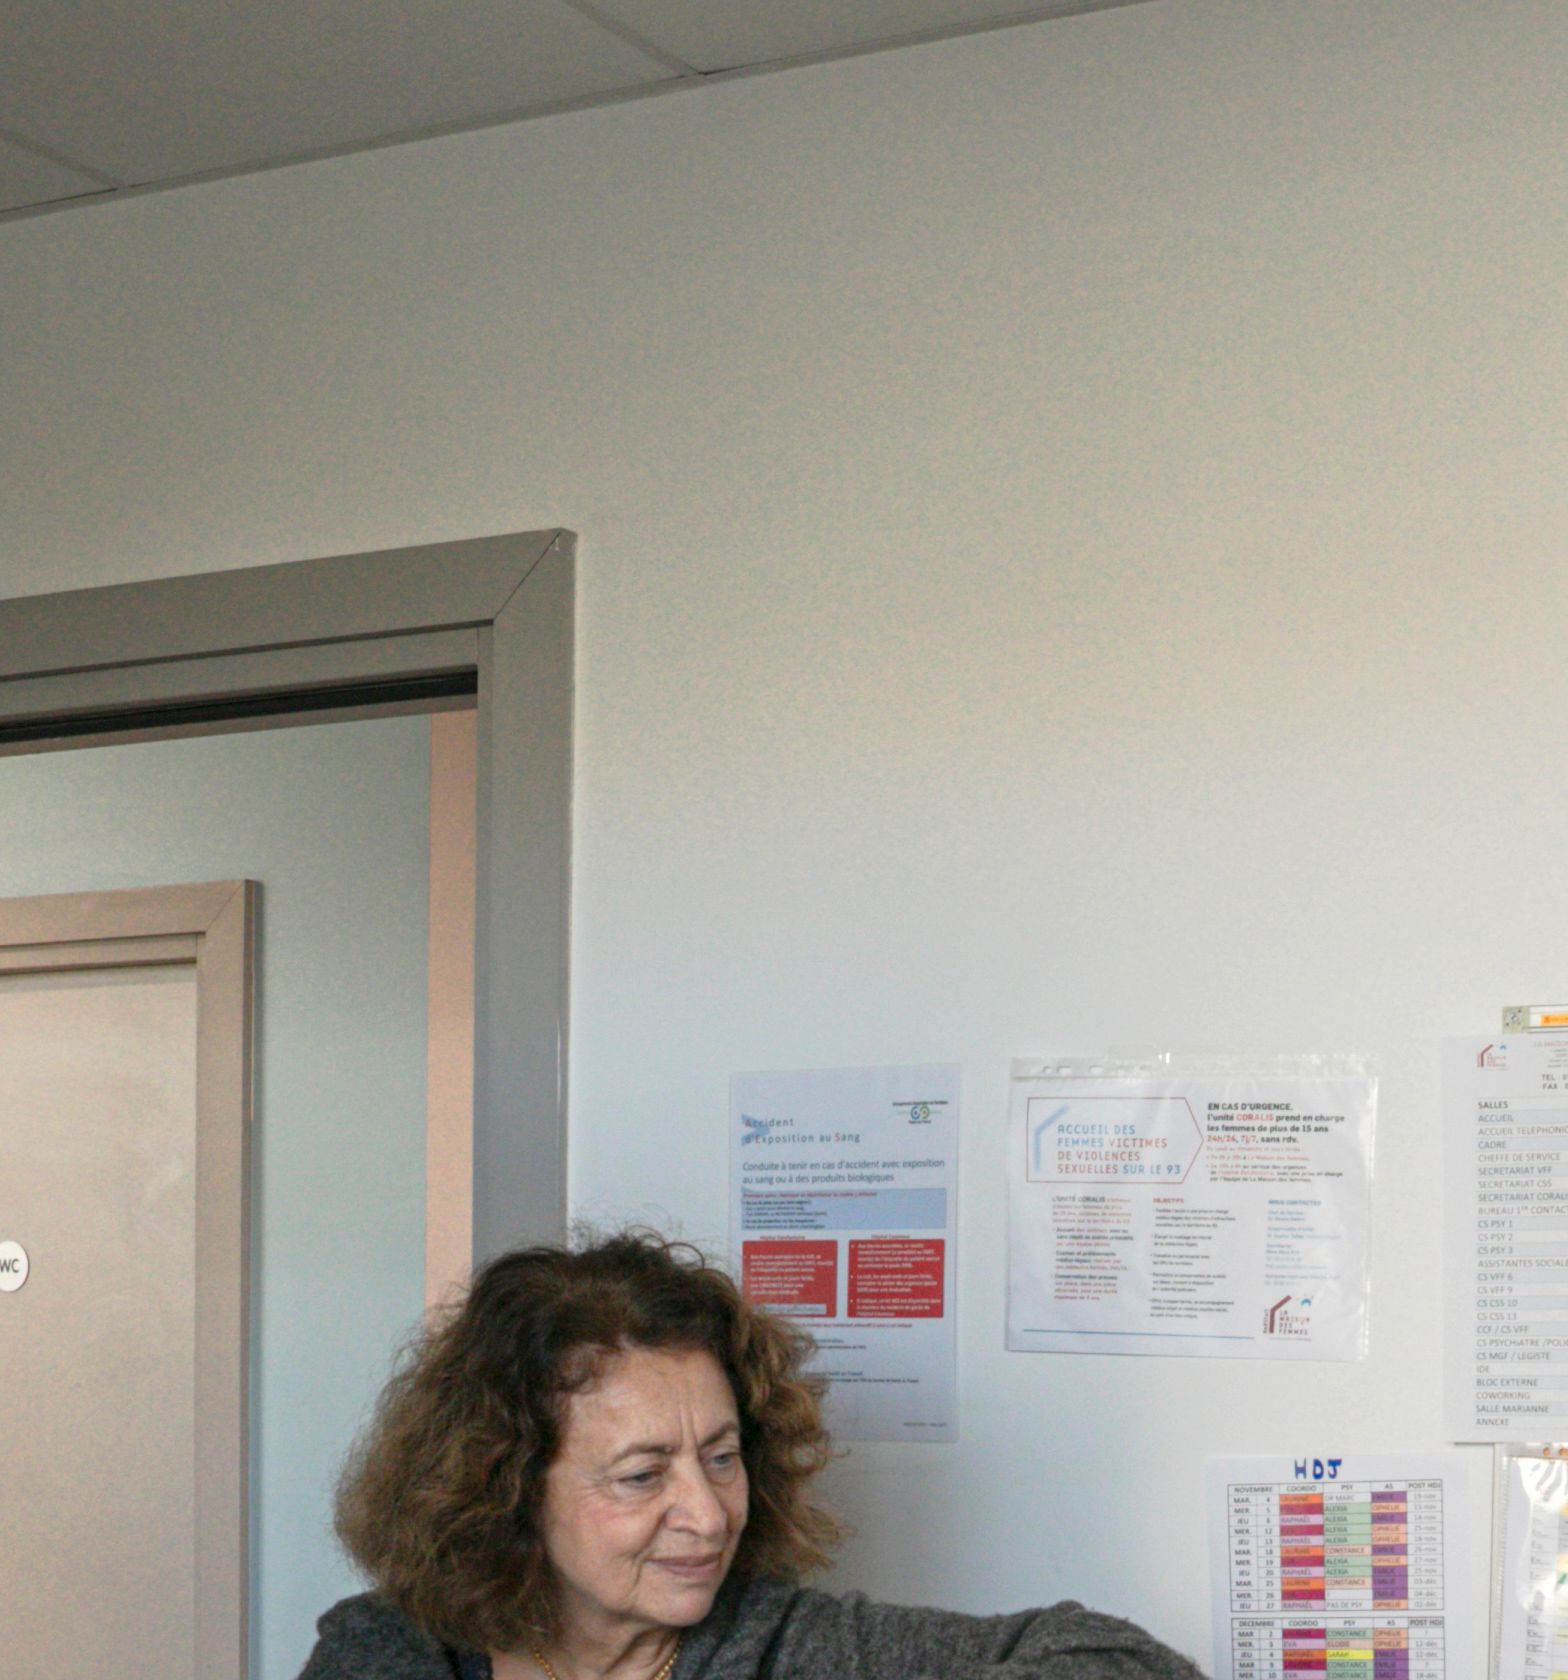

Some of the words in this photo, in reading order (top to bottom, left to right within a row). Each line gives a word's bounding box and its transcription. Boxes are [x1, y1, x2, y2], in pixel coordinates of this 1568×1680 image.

[1207, 1102, 1220, 1111] EN
[1222, 1102, 1239, 1111] CAS
[1478, 1100, 1508, 1110] SALLES
[745, 1118, 794, 1128] Accident
[1207, 1113, 1234, 1122] l'unité
[1236, 1113, 1274, 1122] CORALIS
[1275, 1114, 1300, 1123] prend
[1314, 1114, 1345, 1124] charge
[1478, 1114, 1514, 1123] ACCUEIL
[1057, 1124, 1109, 1135] ACCUEIL
[1114, 1124, 1136, 1135] DES
[1207, 1124, 1219, 1133] les
[1221, 1124, 1255, 1133] femmes
[1257, 1124, 1267, 1133] de
[1269, 1125, 1288, 1134] plus
[1290, 1124, 1300, 1133] de
[1302, 1125, 1311, 1133] 15
[1313, 1125, 1329, 1133] ans
[1478, 1127, 1513, 1136] ACCUEIL
[745, 1133, 814, 1144] d'Exposition
[819, 1135, 831, 1143] au
[835, 1133, 860, 1143] Sang
[1057, 1137, 1104, 1148] FEMMES
[1109, 1137, 1168, 1148] VICTIMES
[1260, 1136, 1280, 1144] sans
[1478, 1141, 1506, 1149] CADRE
[1058, 1150, 1072, 1161] DE
[1076, 1150, 1140, 1161] VIOLENCES
[1478, 1154, 1508, 1162] CHEFFE
[1525, 1152, 1560, 1161] SERVICE
[742, 1161, 779, 1171] Conduite
[781, 1161, 787, 1171] à
[788, 1161, 807, 1170] tenir
[822, 1162, 835, 1170] cas
[837, 1160, 879, 1170] d'accident
[882, 1161, 900, 1169] avec
[902, 1159, 945, 1169] exposition
[1057, 1163, 1119, 1175] SEXUELLES
[1122, 1164, 1144, 1175] SUR
[1150, 1164, 1164, 1175] LE
[1167, 1164, 1182, 1175] 93
[1478, 1167, 1534, 1176] SECRETARIAT
[1537, 1166, 1552, 1174] VFF
[742, 1176, 753, 1184] au
[755, 1176, 773, 1186] sang
[776, 1176, 787, 1184] ou
[788, 1174, 794, 1184] à
[795, 1174, 809, 1184] des
[812, 1173, 845, 1185] produits
[847, 1172, 894, 1184] biologiques
[0, 1258, 20, 1273] WC
[1476, 1378, 1498, 1387] BLOC
[1501, 1378, 1538, 1387] EXTERNE
[1475, 1405, 1499, 1414] SALLE
[1502, 1405, 1549, 1414] MARIANNE
[1294, 1458, 1342, 1479] HDJ
[1234, 1486, 1273, 1494] NOVEMBRE
[1239, 1620, 1274, 1628] DECEMBRE
